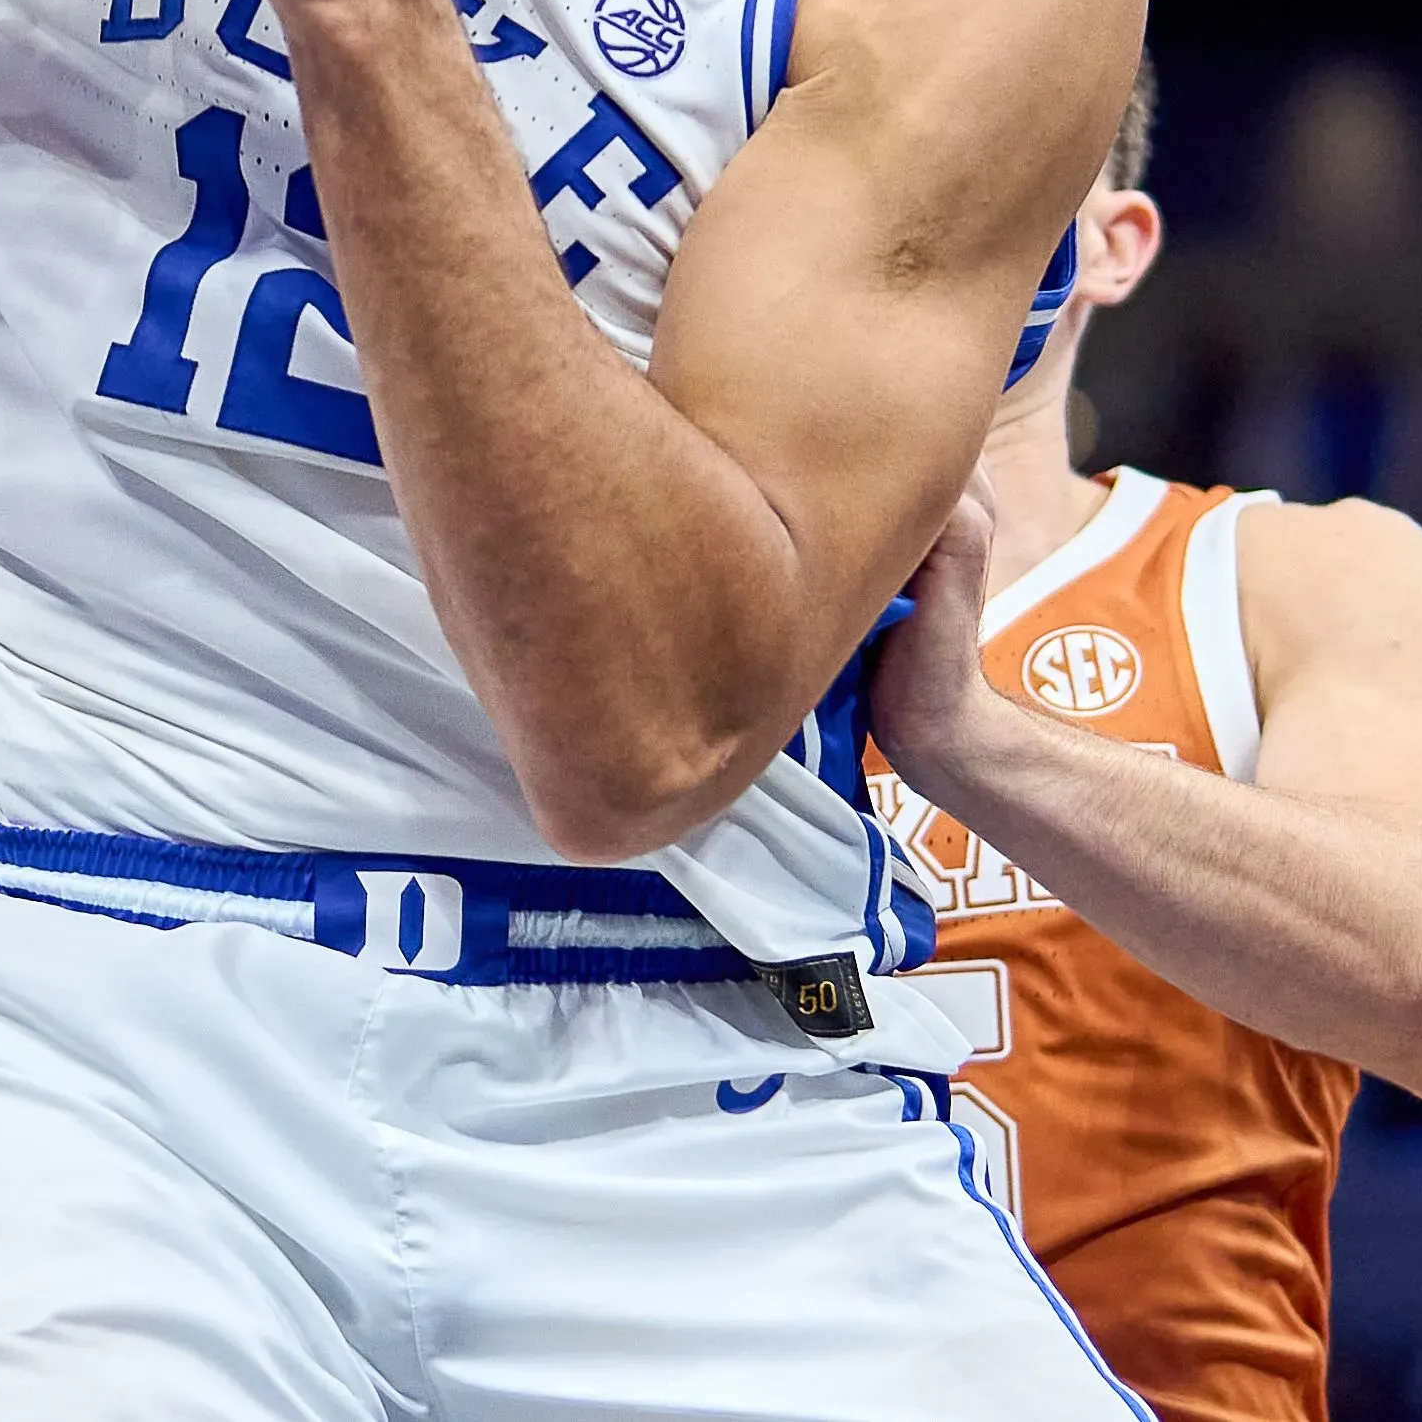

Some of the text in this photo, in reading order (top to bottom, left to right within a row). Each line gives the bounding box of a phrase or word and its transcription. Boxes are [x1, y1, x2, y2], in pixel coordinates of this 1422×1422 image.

[608, 8, 685, 54] ACC
[95, 106, 386, 467] 12
[1031, 629, 1135, 712] SEC
[798, 980, 838, 1015] 50
